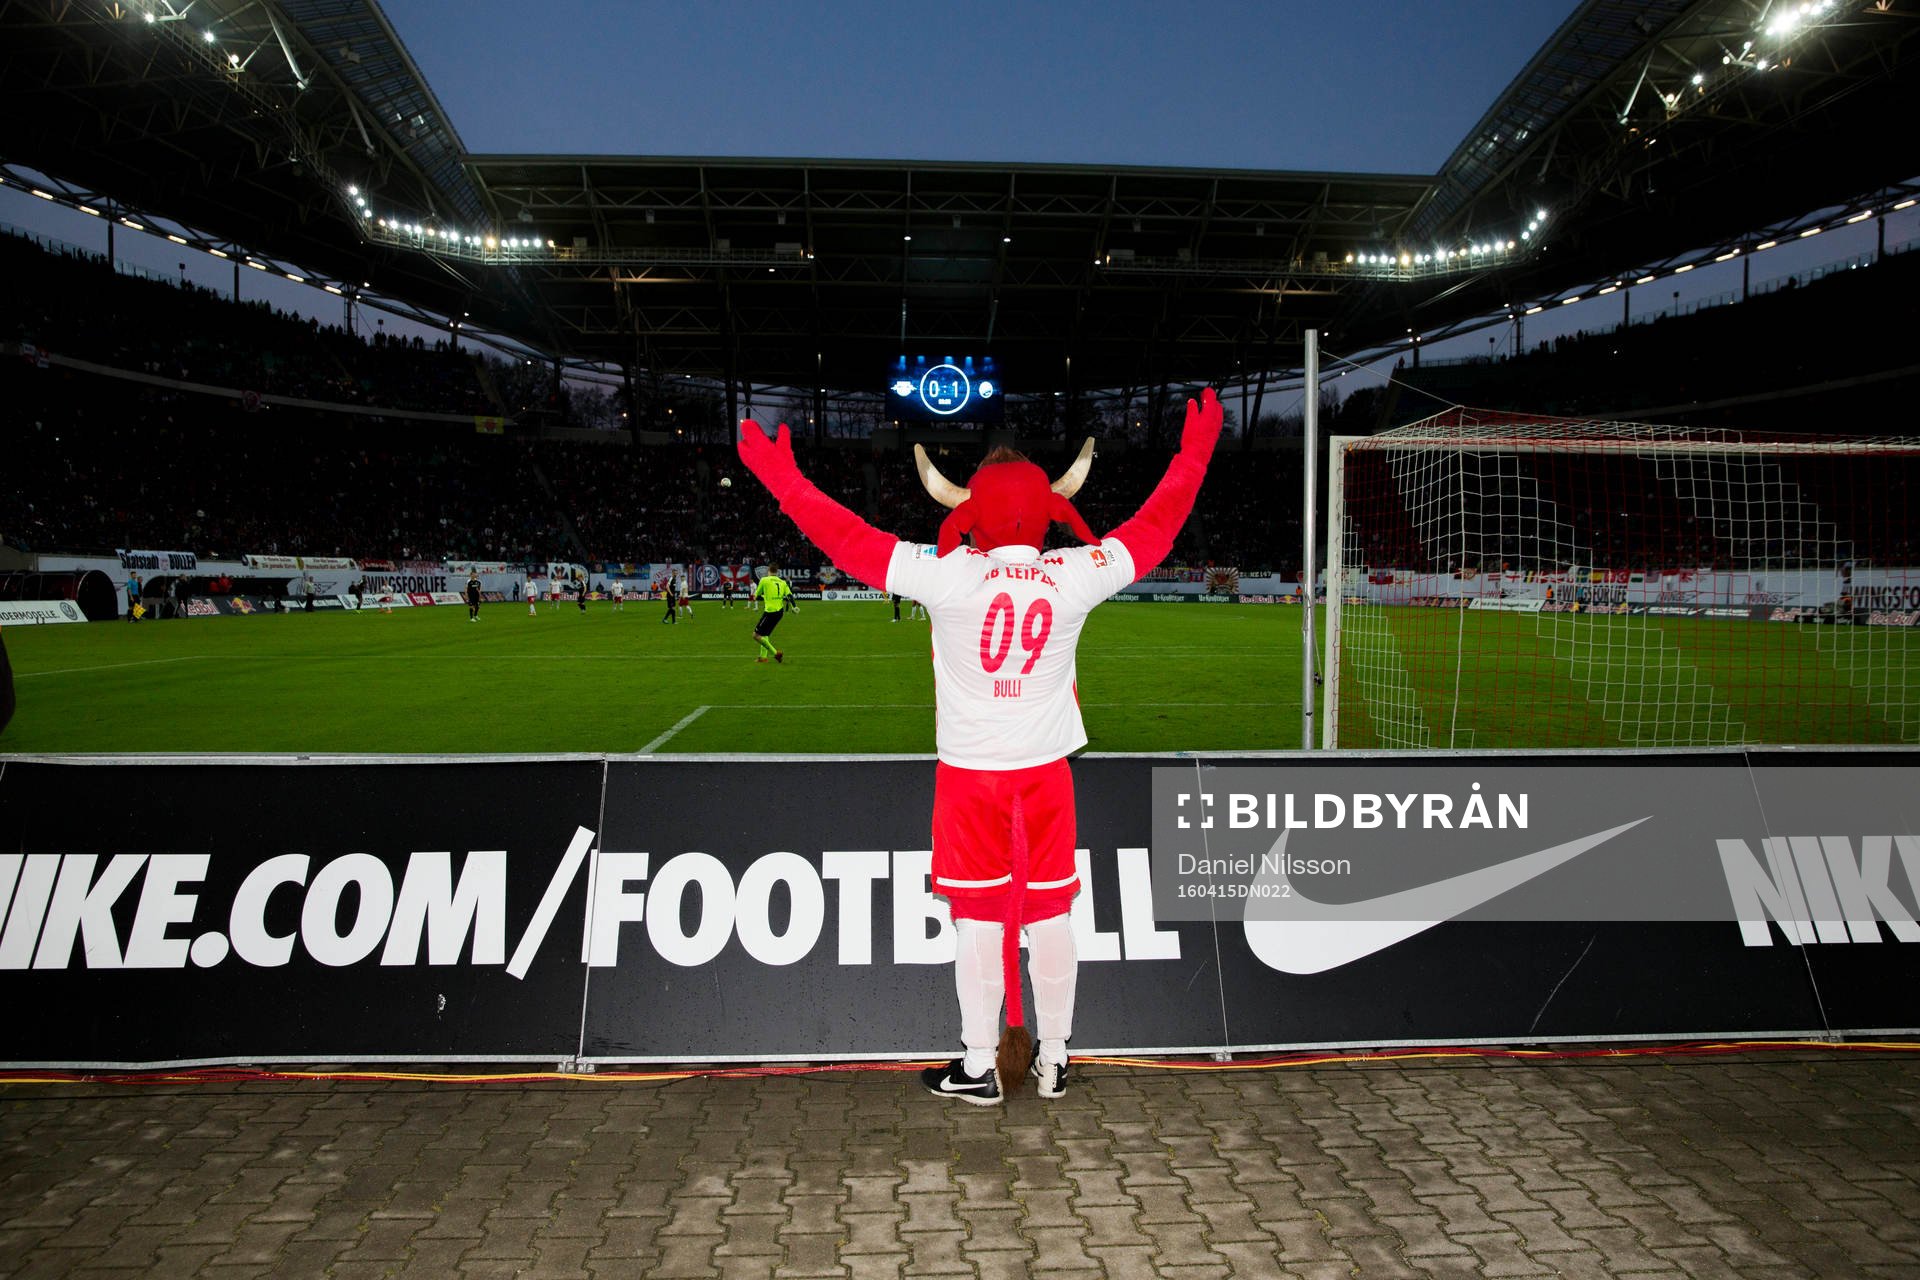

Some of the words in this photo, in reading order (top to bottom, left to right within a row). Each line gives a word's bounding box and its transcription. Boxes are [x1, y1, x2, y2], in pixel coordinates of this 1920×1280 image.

[168, 553, 197, 570] BULLEN
[777, 568, 811, 579] BULLS
[853, 592, 890, 600] ALLSTAR
[979, 591, 1053, 675] 09
[993, 680, 1022, 698] BULLI
[1715, 835, 1920, 946] NIK
[0, 826, 1181, 981] IKE.COM/FOOTBLL
